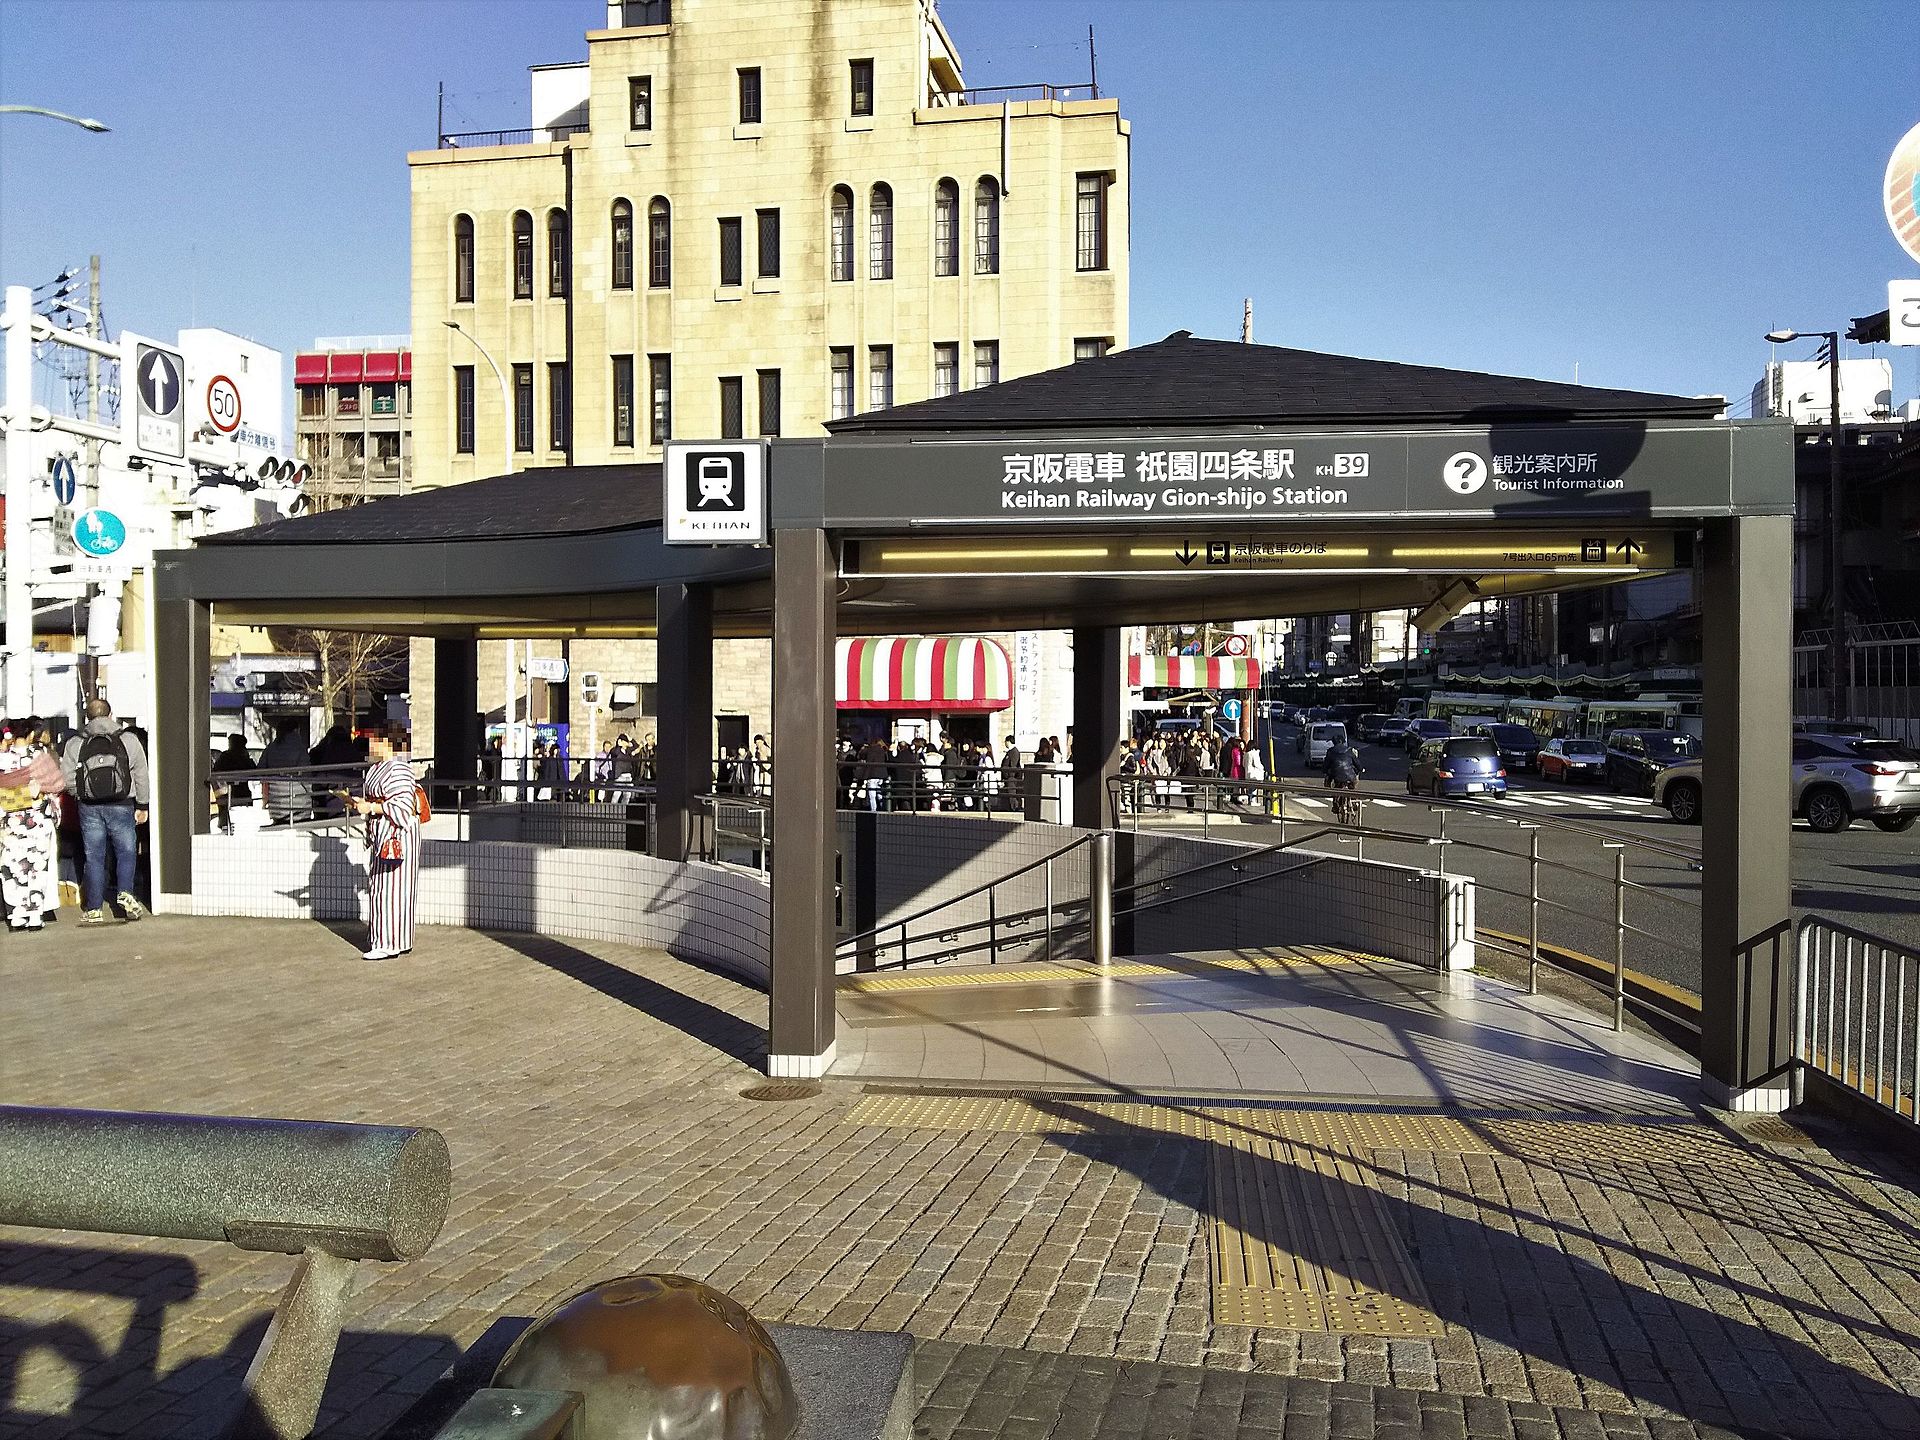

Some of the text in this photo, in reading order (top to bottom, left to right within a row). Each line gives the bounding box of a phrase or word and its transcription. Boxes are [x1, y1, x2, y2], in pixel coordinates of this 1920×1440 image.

[213, 388, 235, 418] 50
[1002, 452, 1125, 484] 京阪電車
[1135, 449, 1295, 483] 祇園四条駅
[1492, 452, 1599, 474] 観光案内所
[1493, 476, 1624, 491] Tourist Information
[1001, 485, 1348, 511] Keihan Railway Gion-shijo Station
[692, 522, 750, 530] KEIHAN
[1234, 541, 1328, 556] 京阪電車のりば
[1502, 552, 1577, 562] 7号出入口65m先
